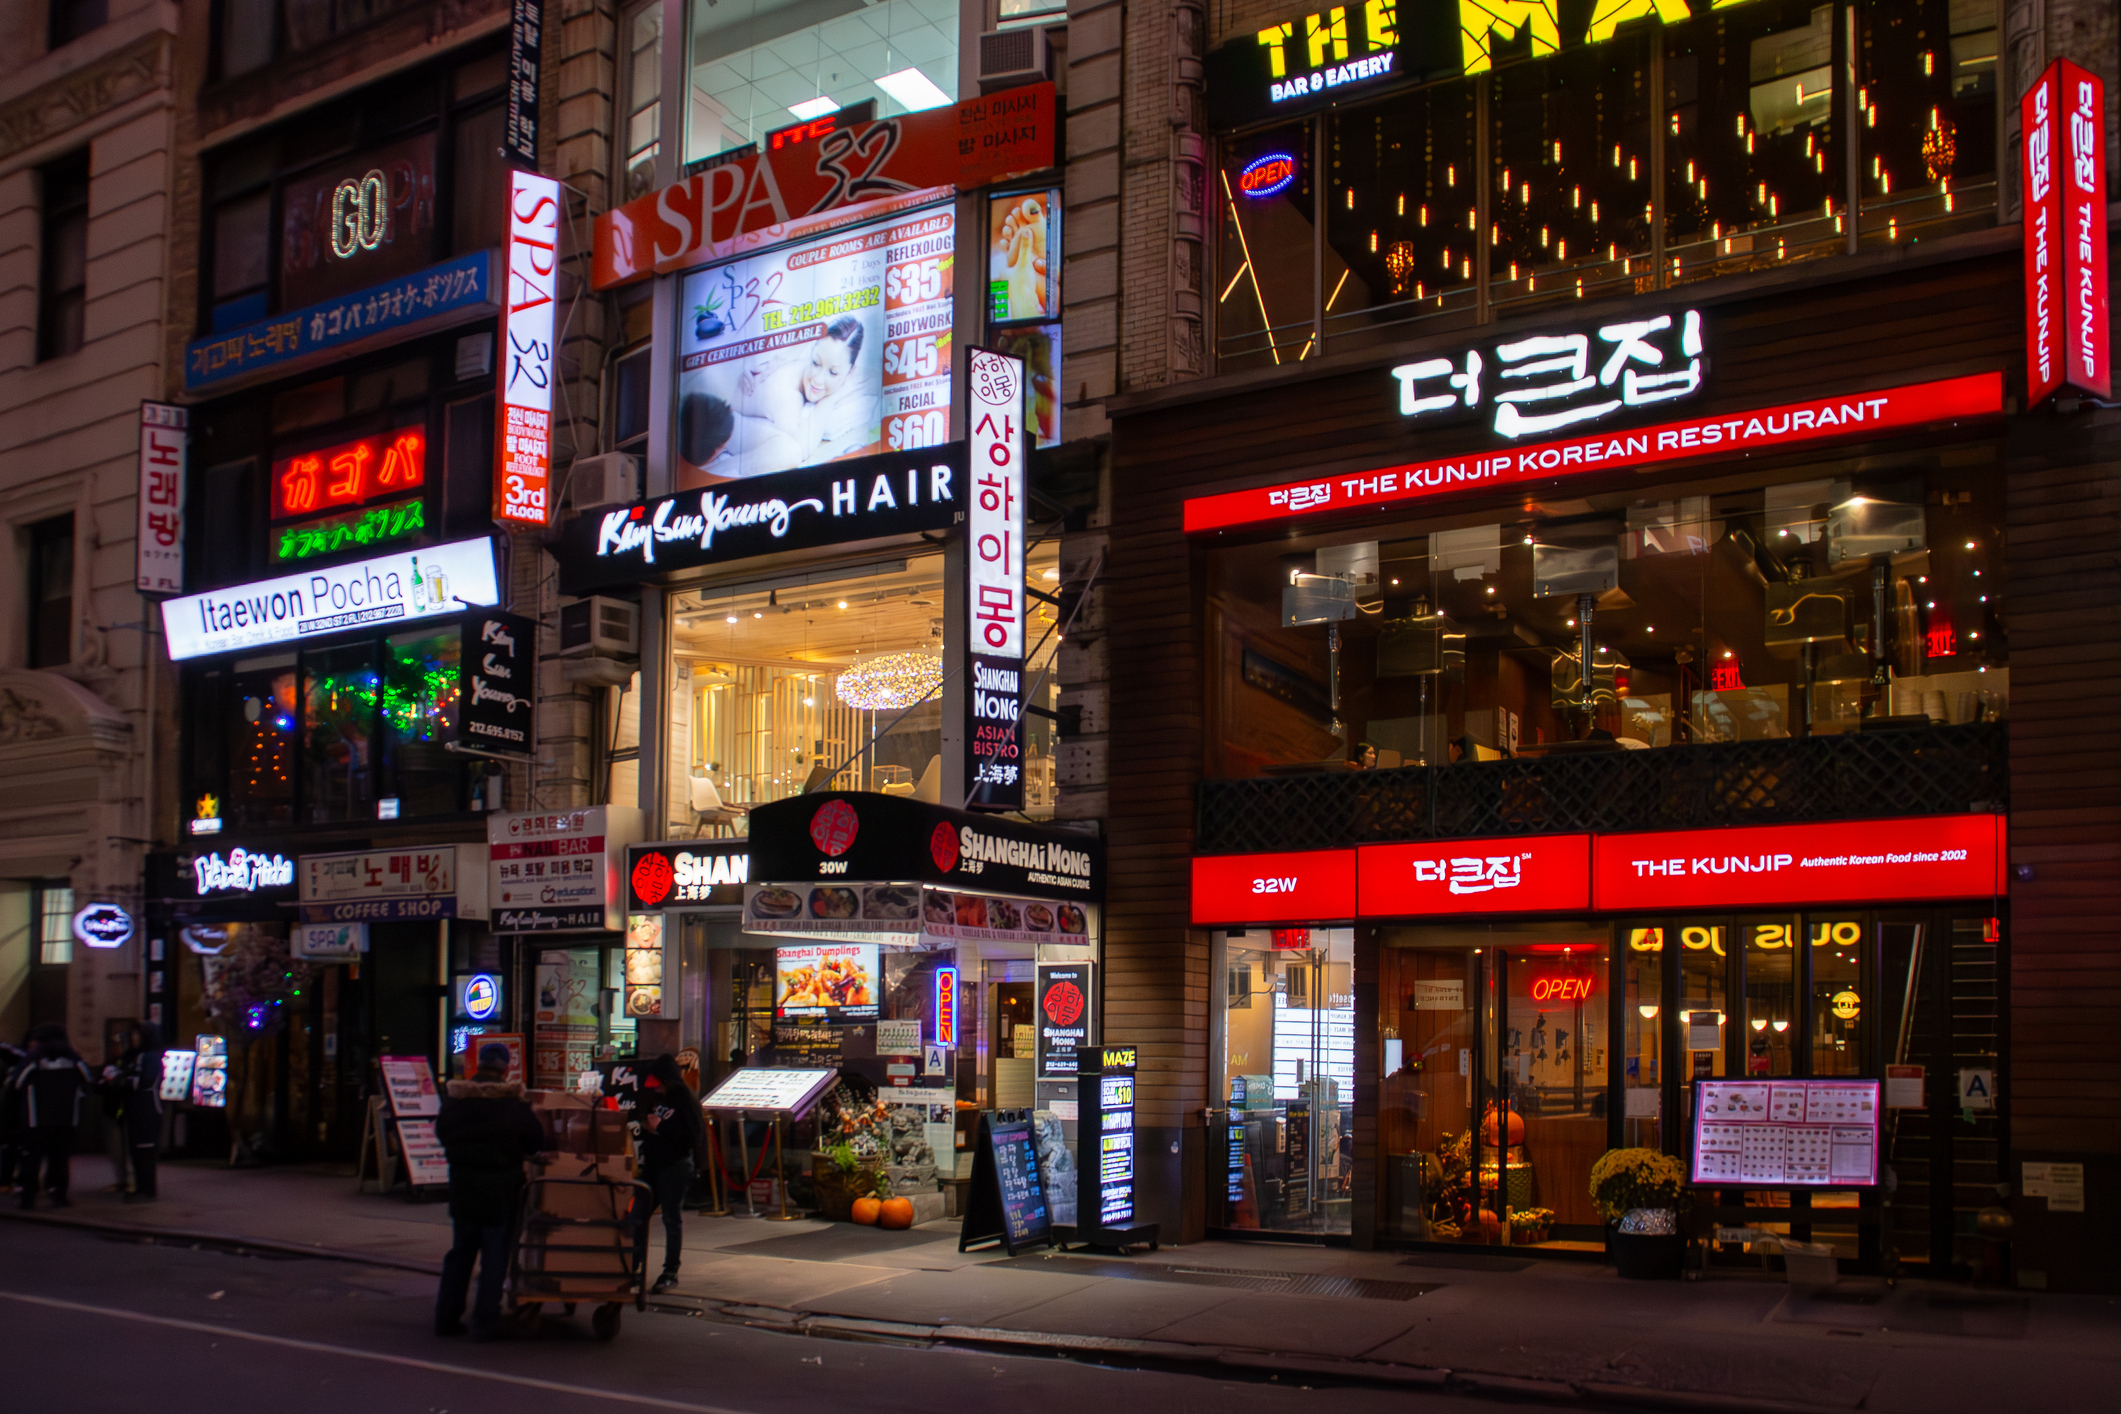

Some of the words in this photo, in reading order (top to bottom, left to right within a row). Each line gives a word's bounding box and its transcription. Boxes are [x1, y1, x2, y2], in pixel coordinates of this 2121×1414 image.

[511, 23, 524, 80] BEAUTY
[1257, 0, 1399, 77] THE
[1271, 76, 1309, 102] BAR
[1309, 71, 1323, 91] &
[1325, 52, 1394, 87] EATERY
[507, 79, 521, 147] INSTITUTE
[992, 93, 1036, 117] 마사지
[983, 125, 1036, 149] 마사지
[653, 154, 791, 264] SPA
[806, 117, 924, 216] 32
[1240, 159, 1293, 192] OPEN
[331, 169, 388, 259] GO
[788, 249, 827, 268] COUPLE
[828, 239, 865, 261] ROOMS
[865, 233, 889, 250] ARE
[889, 216, 950, 244] AVAILABLE
[2035, 206, 2048, 274] THE
[2078, 202, 2092, 264] THE
[508, 188, 559, 315] SPA
[886, 235, 954, 265] REFLEXOLOG
[886, 257, 942, 305] $35
[762, 310, 787, 332] TEL.
[790, 286, 880, 326] 212.967.3232
[2079, 266, 2095, 379] KUNJIP
[887, 311, 952, 338] BODYWORK
[2036, 274, 2050, 384] KUNJIP
[507, 327, 550, 394] 32
[685, 354, 707, 369] GIFT
[707, 339, 766, 363] CERTIFICATE
[766, 326, 823, 349] AVAILABLE
[884, 334, 939, 379] $45
[1392, 309, 1704, 438] 더큰집
[899, 391, 936, 412] FACIAL
[507, 424, 548, 441] BODYWORK
[888, 410, 945, 451] $60
[514, 453, 540, 467] FOOT
[1341, 474, 1399, 499] THE
[1404, 457, 1512, 490] KUNJIP
[1518, 434, 1649, 472] KOREAN
[1657, 398, 1889, 451] RESTAURANT
[505, 475, 546, 508] 3rd
[1269, 483, 1331, 510] 더큰집
[505, 503, 545, 521] FLOOR
[597, 505, 655, 564] Kim
[653, 499, 704, 543] Sun
[701, 491, 824, 550] Young
[832, 465, 953, 517] HAIR
[199, 588, 304, 635] Itaewon
[310, 566, 404, 614] Pocha
[481, 620, 516, 658] Kim
[1928, 630, 1955, 655] EXIT
[973, 660, 1019, 693] SHANGHAI
[1717, 665, 1743, 688] EXIT
[471, 675, 532, 714] Young
[973, 689, 1019, 721] MONG
[976, 725, 1016, 743] ASIAN
[973, 740, 1019, 759] BISTRO
[523, 840, 557, 857] NAIL
[558, 837, 590, 855] BAR
[1047, 842, 1091, 877] MONG
[819, 861, 848, 875] 30W
[1414, 855, 1522, 896] 더큰집
[1631, 858, 1686, 878] THE
[1691, 853, 1793, 875] KUNJIP
[1800, 855, 1848, 868] Authentic
[1849, 855, 1885, 866] Korean
[1885, 852, 1912, 864] Food
[1912, 851, 1939, 863] since
[1940, 849, 1968, 861] 2002
[1027, 871, 1057, 885] AUTHENTIC
[1057, 876, 1072, 888] ASIAN
[1072, 879, 1091, 890] CUISINE
[1251, 876, 1298, 894] 32W
[333, 901, 390, 920] COFFEE
[397, 899, 442, 917] SHOP
[568, 912, 601, 925] HAIR
[308, 929, 336, 948] SPA
[777, 946, 815, 959] Shanghai
[816, 945, 861, 958] Dumplings
[1050, 972, 1072, 980] Welcome
[1533, 977, 1592, 1001] OPEN
[939, 973, 953, 1043] OPEN
[1043, 1027, 1084, 1038] SHANGHAI
[1051, 1037, 1076, 1047] MONG
[569, 1051, 592, 1072] $35
[929, 1050, 941, 1067] A
[1103, 1050, 1135, 1067] MAZE
[610, 1065, 639, 1092] Kim
[1965, 1074, 1988, 1098] A
[1118, 1087, 1132, 1105] $10
